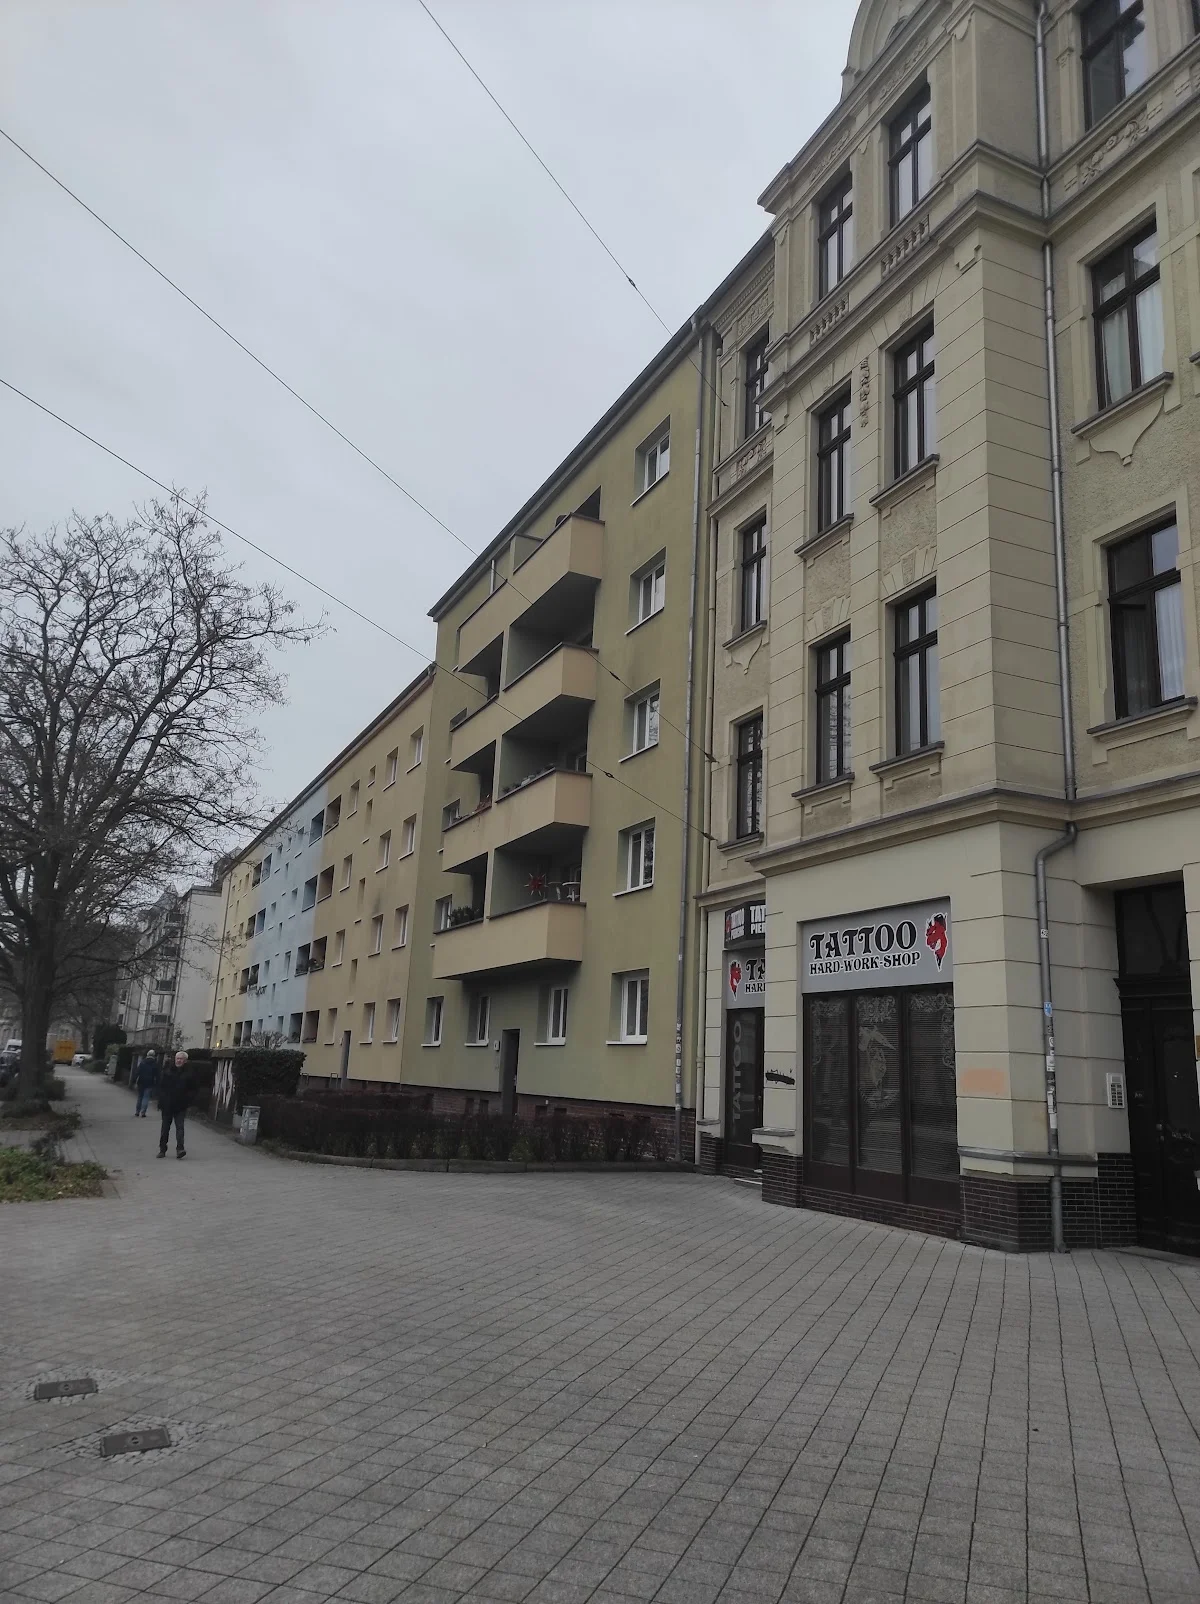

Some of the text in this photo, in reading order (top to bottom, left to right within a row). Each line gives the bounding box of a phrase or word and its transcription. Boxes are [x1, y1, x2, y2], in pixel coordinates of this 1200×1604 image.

[809, 920, 917, 960] TATTOO
[809, 951, 921, 975] HARD-WORK-SHOP
[733, 1021, 742, 1125] TATTOO
